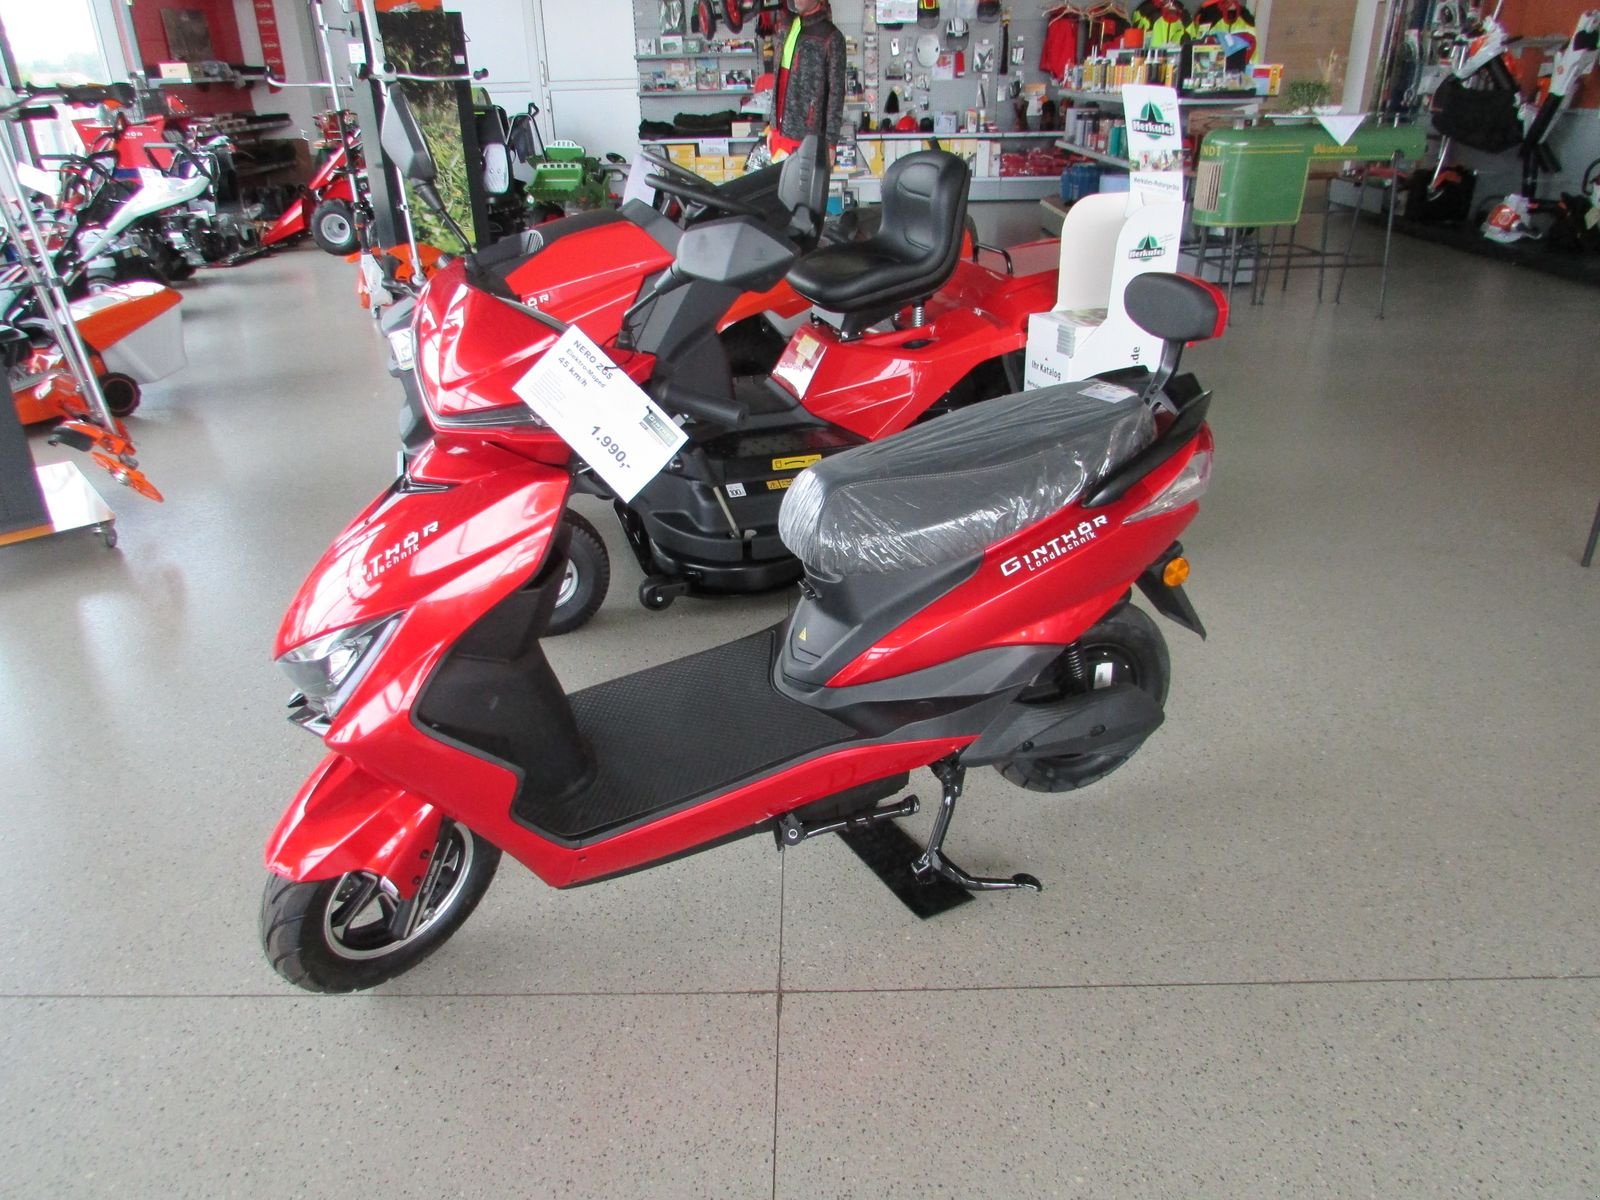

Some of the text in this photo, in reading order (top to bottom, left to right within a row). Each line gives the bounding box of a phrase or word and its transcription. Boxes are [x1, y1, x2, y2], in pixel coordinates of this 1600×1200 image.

[573, 340, 596, 364] NERO
[558, 356, 588, 387] 45 km/h
[1031, 360, 1061, 381] Ihr Katalog
[591, 425, 631, 469] 1.990,-
[1000, 514, 1109, 577] GINTHÖR
